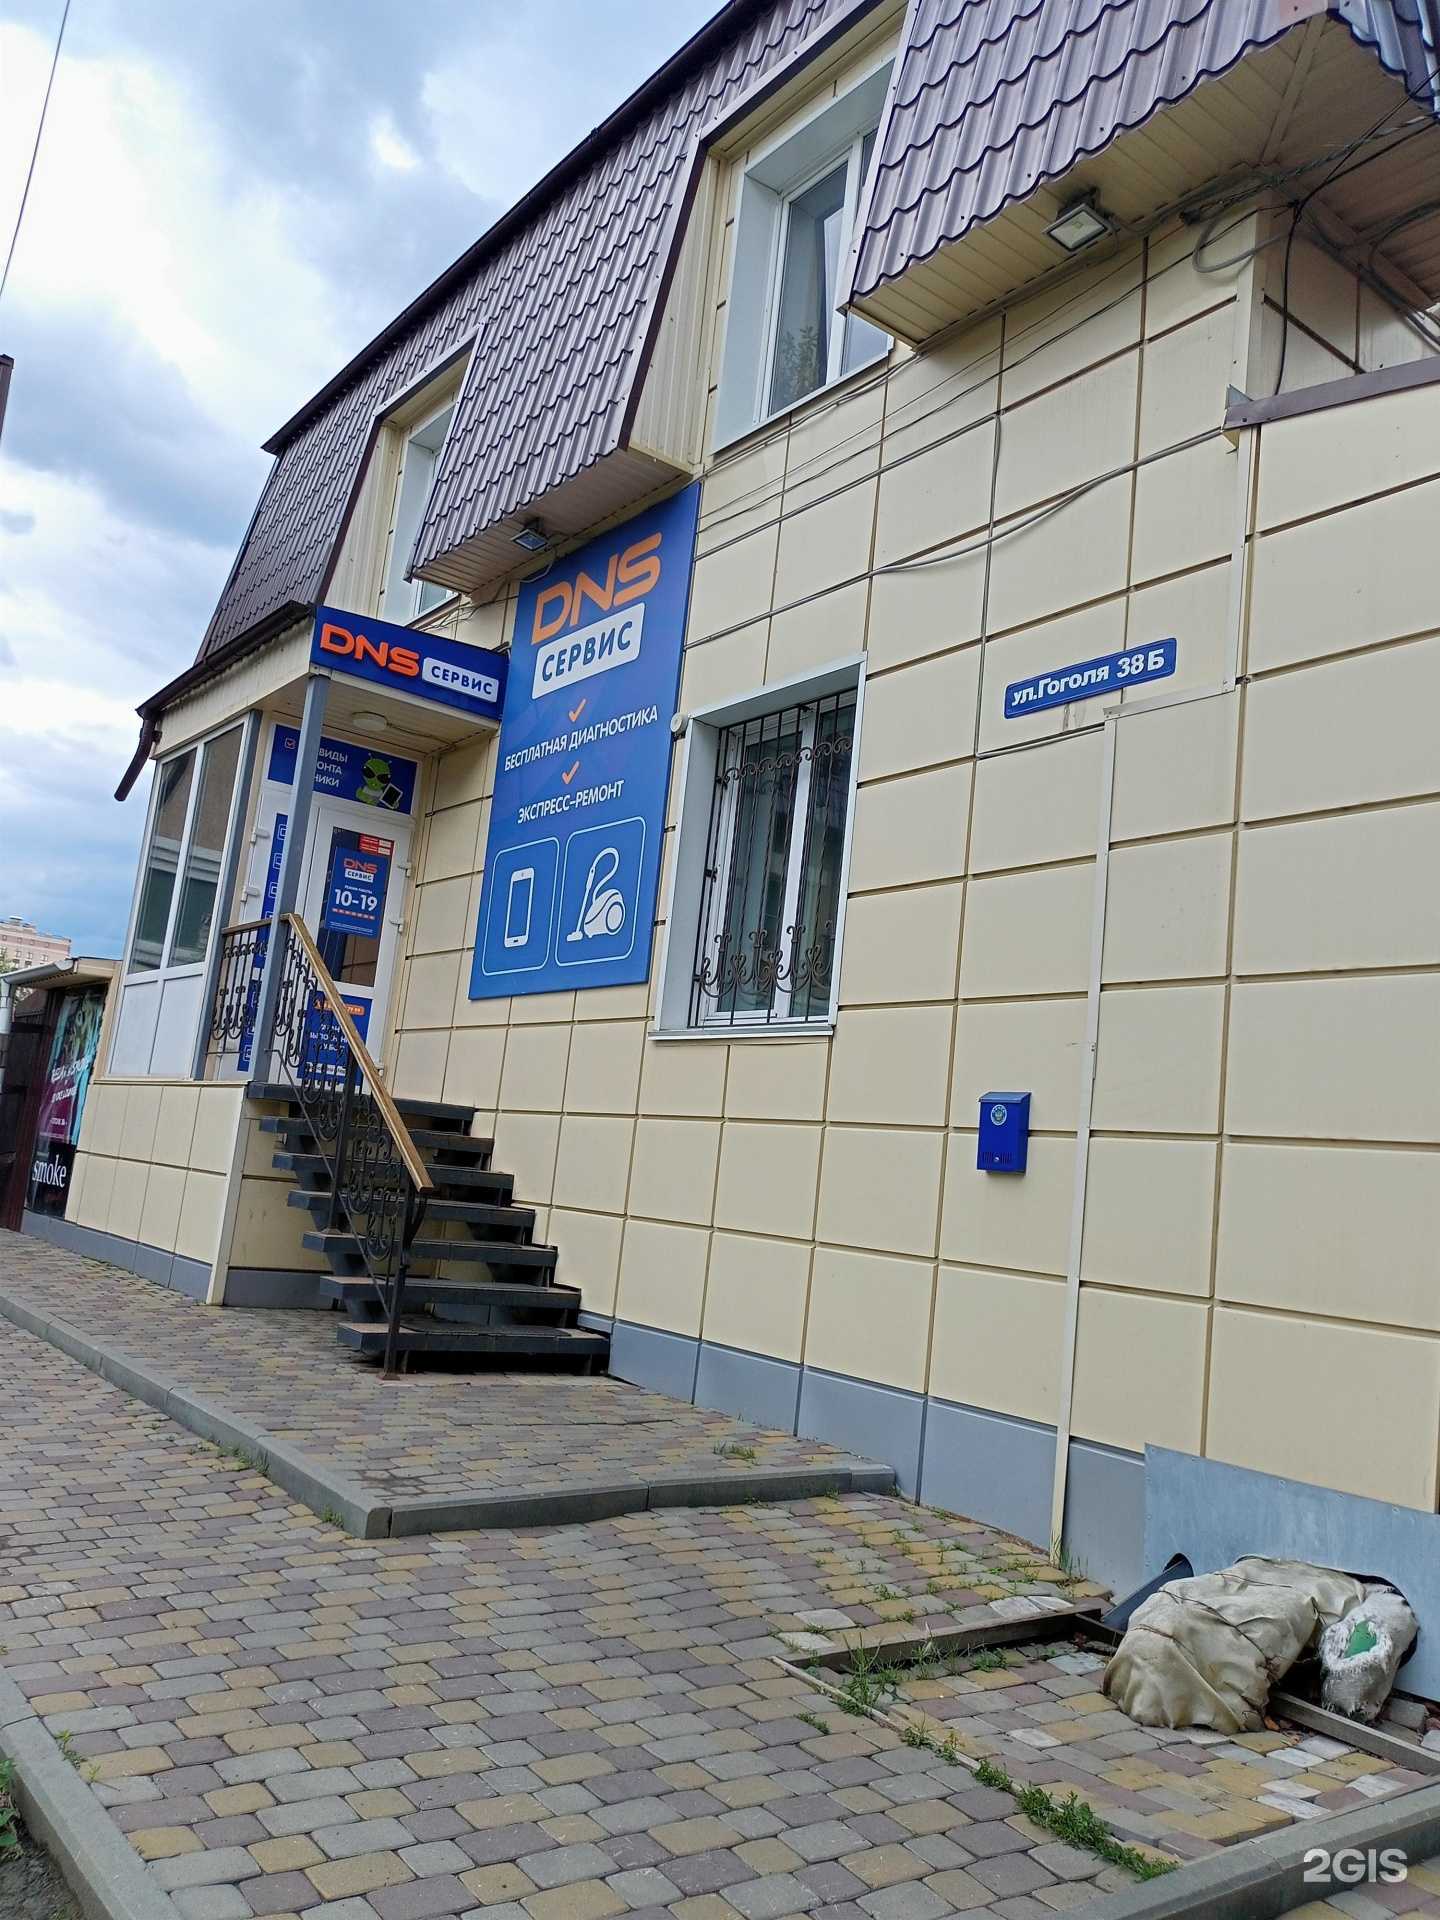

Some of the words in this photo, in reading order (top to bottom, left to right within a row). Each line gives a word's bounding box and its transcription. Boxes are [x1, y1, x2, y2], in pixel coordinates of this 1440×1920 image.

[530, 531, 663, 645] DNS
[320, 622, 420, 677] DNS
[541, 620, 634, 682] СЕРВИС
[430, 664, 493, 695] СЕРВИС
[1011, 665, 1110, 706] ул.Гоголя
[319, 747, 348, 763] ВИДЫ
[504, 734, 567, 771] БЕСПЛАТНАЯ
[568, 704, 658, 750] ДИАГНОСТИКА
[517, 779, 625, 825] ЭКСПРЕСС-РЕМОНТ
[344, 858, 378, 874] DNS
[347, 870, 373, 881] СЕРВИС
[334, 888, 378, 912] 10-19
[31, 1154, 67, 1188] smoke
